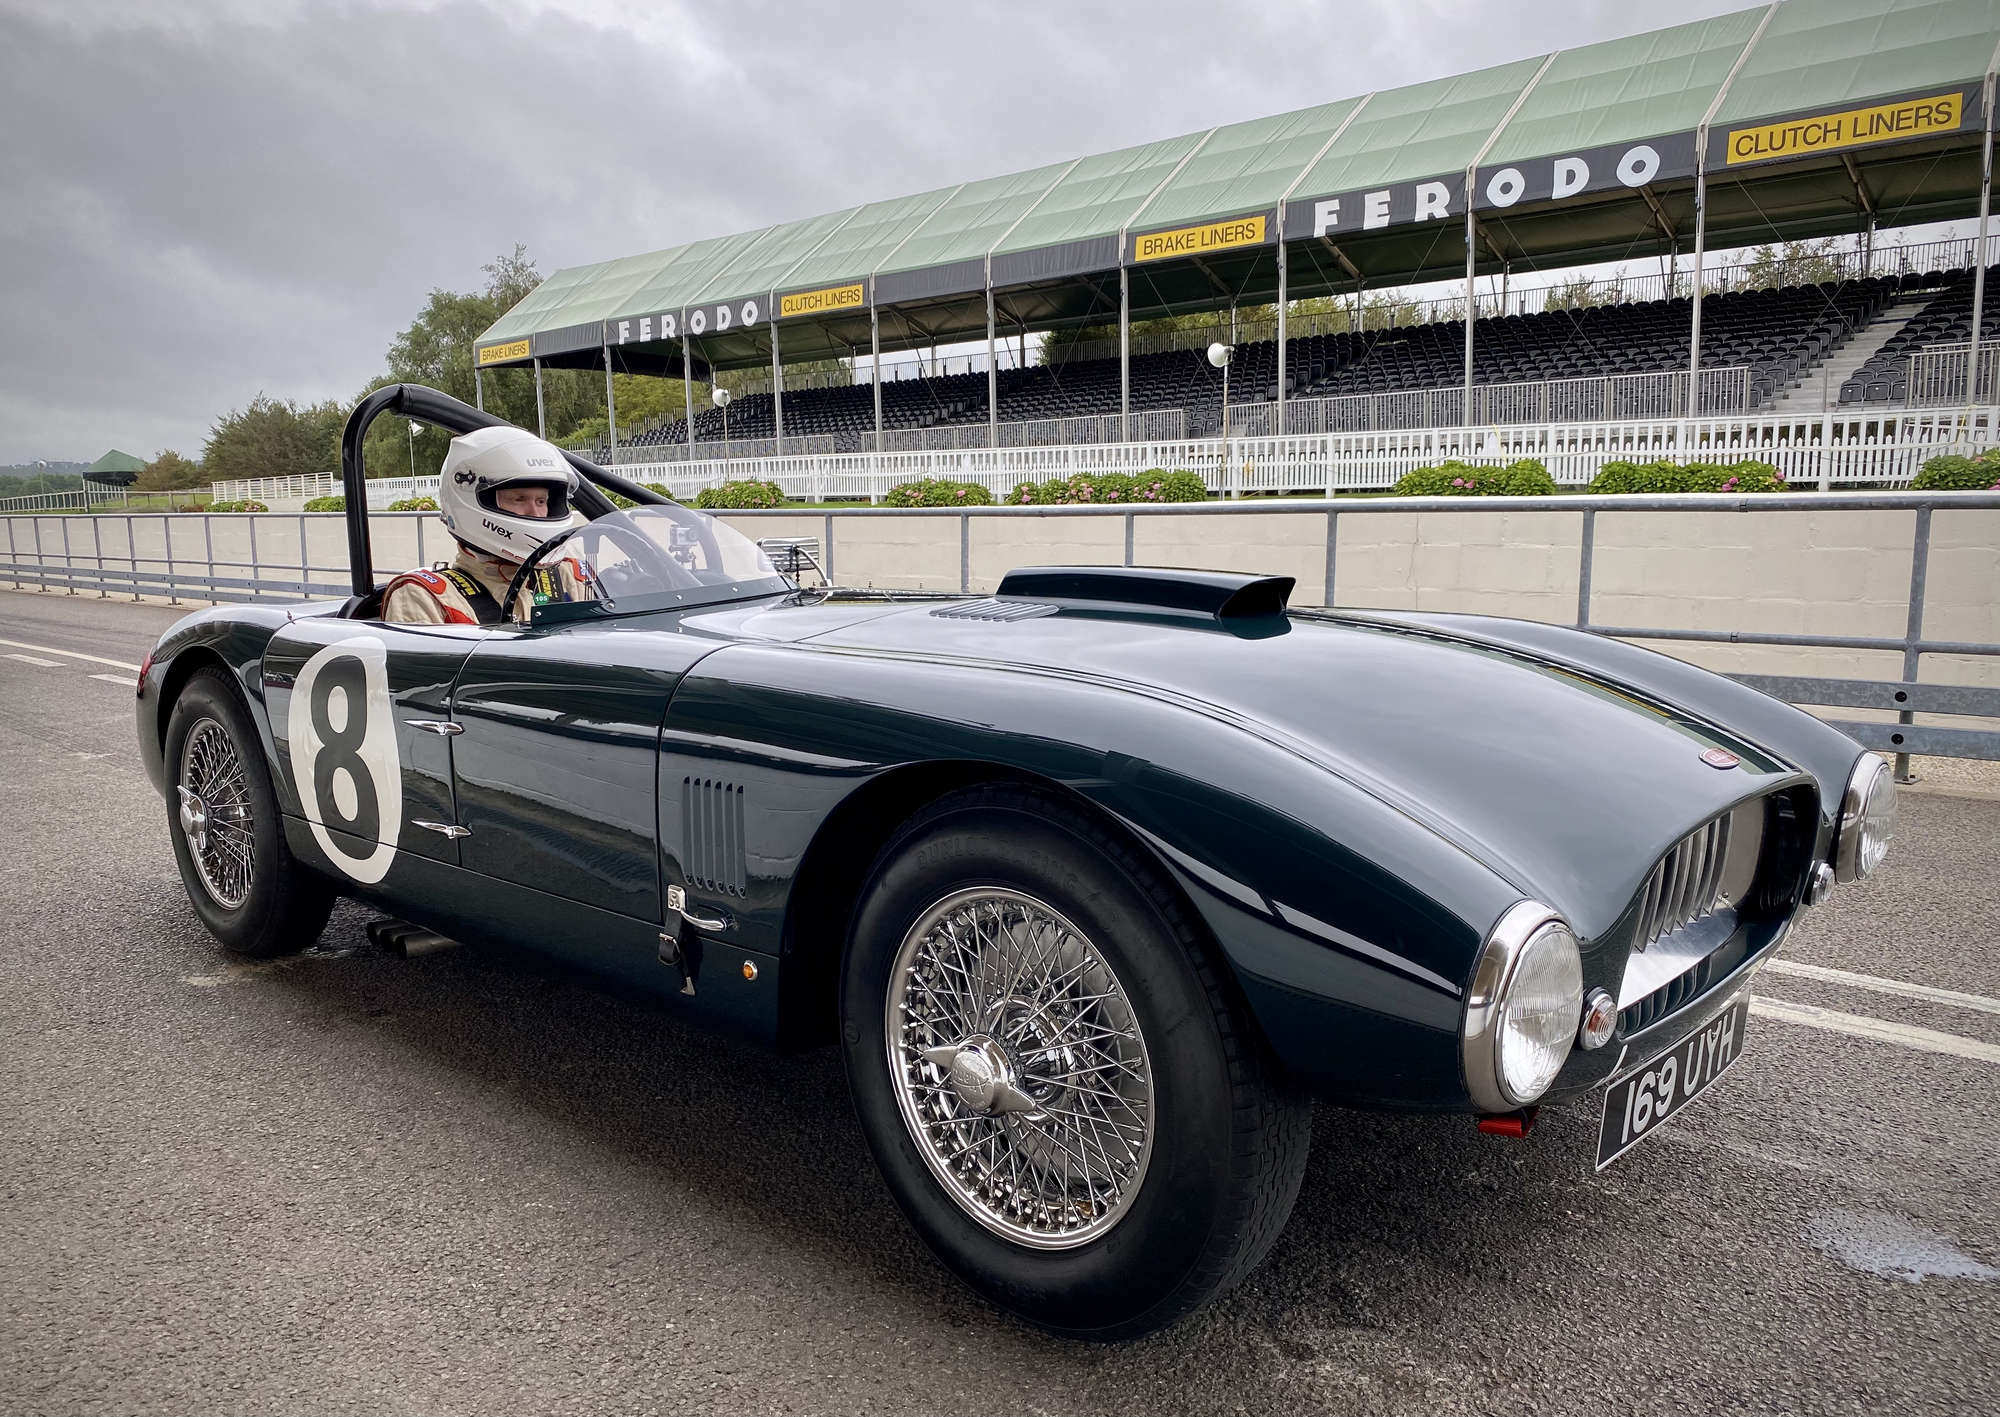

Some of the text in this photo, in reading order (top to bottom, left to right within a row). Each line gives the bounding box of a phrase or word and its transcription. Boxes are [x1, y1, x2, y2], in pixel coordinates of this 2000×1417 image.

[1735, 101, 1953, 157] CLUTCH LINERS
[1313, 145, 1661, 238] FERODO
[1143, 222, 1256, 256] BRAKE LINERS
[783, 288, 860, 312] CLUTCH LINERS
[618, 301, 758, 344] FERODO
[482, 343, 526, 361] BRAKE LINERS
[482, 518, 513, 540] uvex
[310, 654, 380, 861] 8
[1621, 1005, 1738, 1145] 169 UYH
